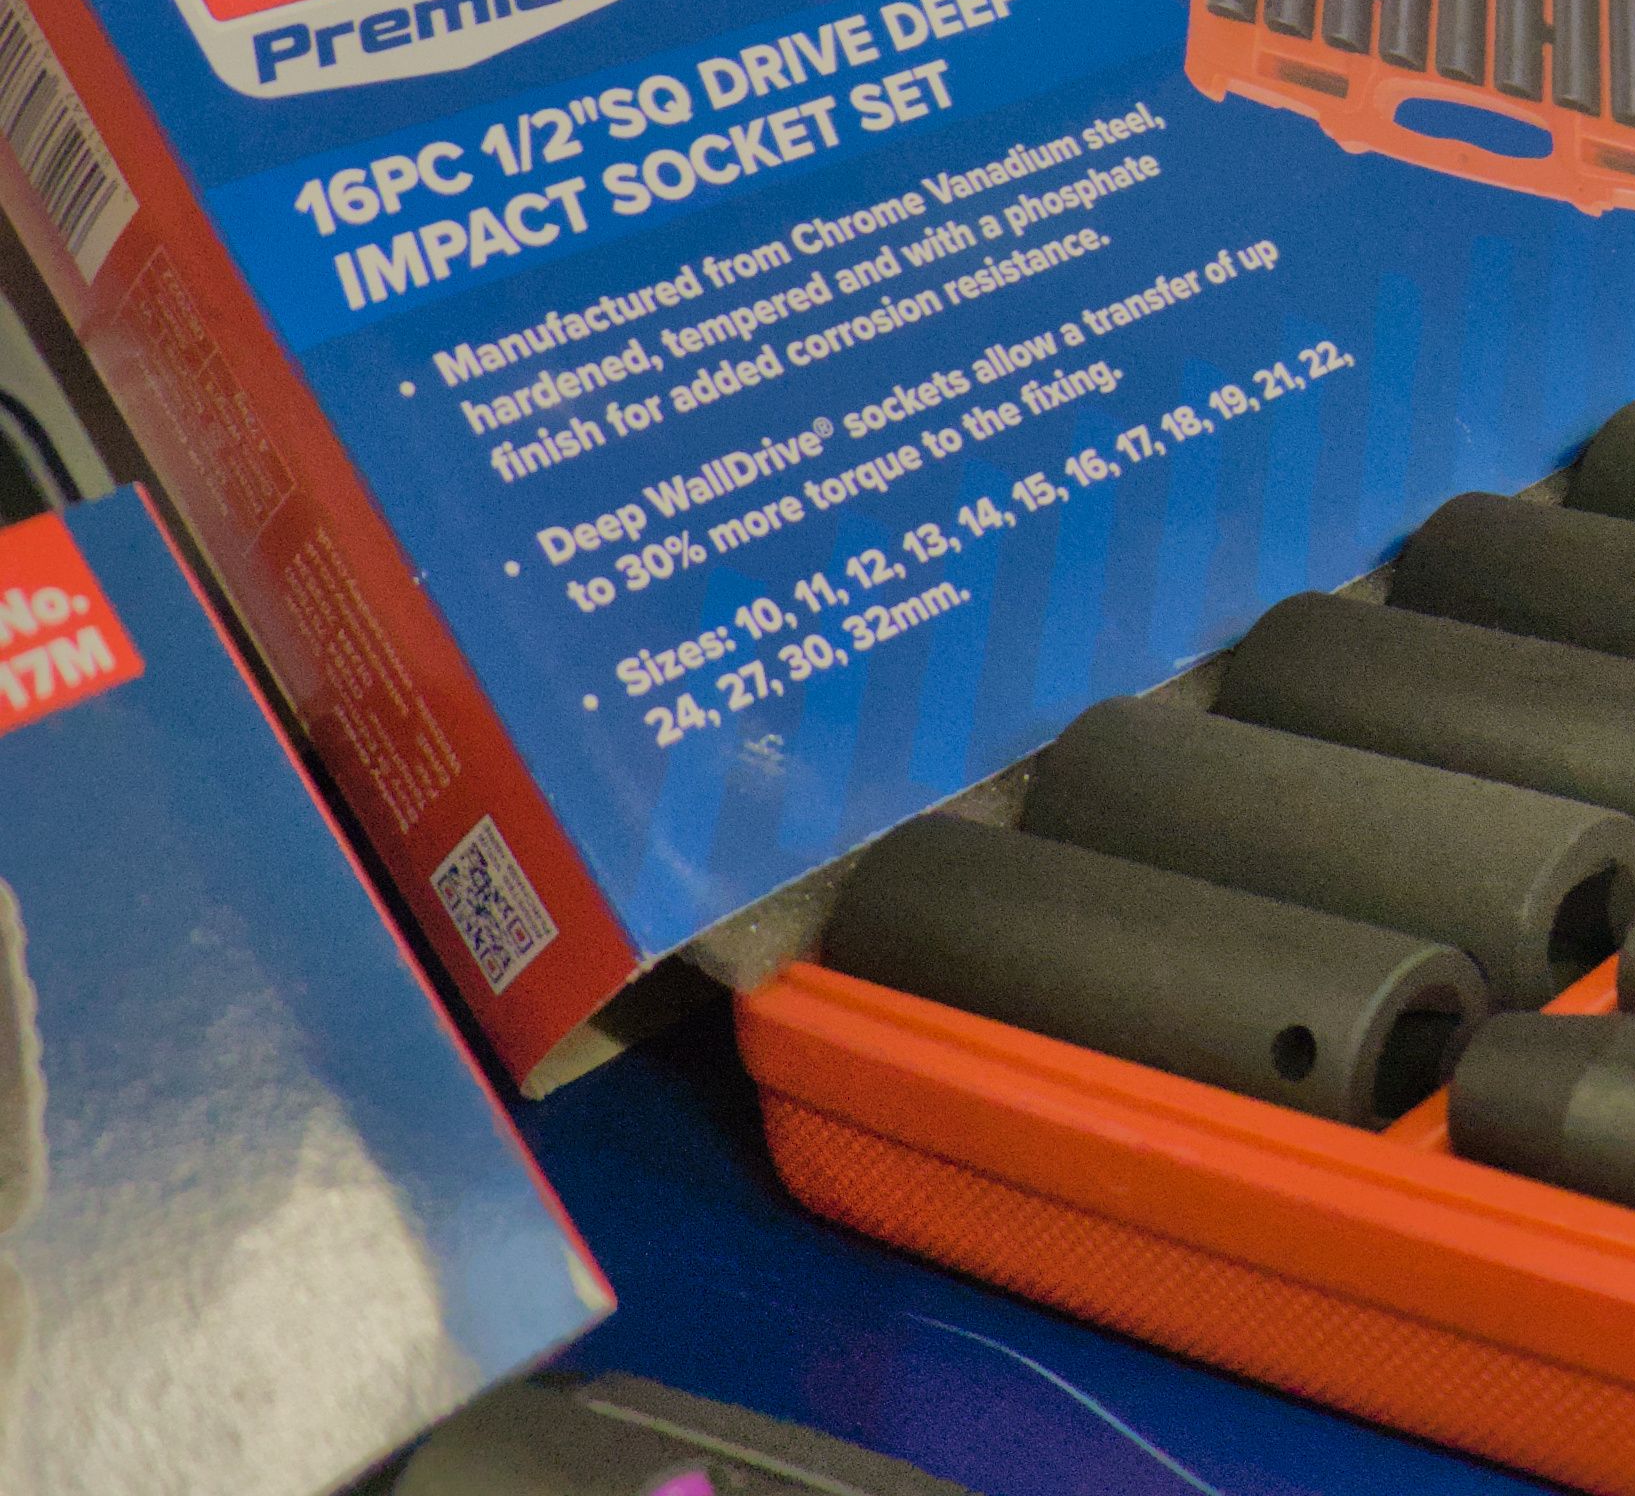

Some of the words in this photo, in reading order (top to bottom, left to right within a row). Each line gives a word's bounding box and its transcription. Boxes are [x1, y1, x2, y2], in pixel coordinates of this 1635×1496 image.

[294, 141, 473, 235] 16PC
[482, 75, 692, 175] 1/2"SQ
[698, 15, 879, 109] DRIVE
[334, 177, 588, 310] IMPACT
[603, 96, 838, 215] SOCKET
[850, 59, 951, 131] SET
[433, 265, 703, 386] Manufactured
[703, 242, 792, 287] from
[791, 193, 926, 254] Chrome
[922, 136, 1082, 204] Vanadium
[1082, 103, 1165, 150] steel,
[461, 339, 663, 434] hardened,
[661, 271, 833, 357] tempered
[835, 246, 902, 293] and
[901, 221, 977, 266] with
[979, 215, 1003, 239] a
[1004, 156, 1160, 236] phosphate
[492, 417, 606, 482] finish
[606, 396, 663, 436] for
[670, 344, 784, 412] added
[787, 290, 943, 366] corrosion
[944, 228, 1110, 304] resistance.
[537, 504, 647, 565] Deep
[844, 364, 970, 439] sockets
[973, 330, 1058, 384] allow
[1060, 323, 1085, 346] a
[1083, 271, 1200, 335] transfer
[1204, 250, 1236, 285] of
[1240, 239, 1279, 273] up
[568, 577, 615, 612] to
[615, 531, 707, 590] 30%
[708, 495, 805, 554] more
[805, 446, 922, 510] torque
[922, 425, 962, 459] to
[962, 399, 1023, 442] the
[1021, 361, 1122, 415] fixing.
[616, 627, 735, 696] Sizes:
[735, 598, 797, 639] 10,
[795, 573, 849, 612] 11,
[847, 549, 906, 589] 12,
[903, 523, 961, 562] 13,
[958, 497, 1016, 536] 14,
[1012, 472, 1069, 511] 15,
[1065, 449, 1121, 486] 16,
[1116, 425, 1166, 462] 17,
[1161, 406, 1214, 441] 18,
[1209, 385, 1260, 419] 19,
[1254, 362, 1305, 400] 21,
[1299, 341, 1354, 379] 22,
[644, 693, 720, 747] 24,
[717, 660, 784, 711] 27,
[778, 635, 848, 681] 30,
[843, 583, 970, 650] 32mm.
